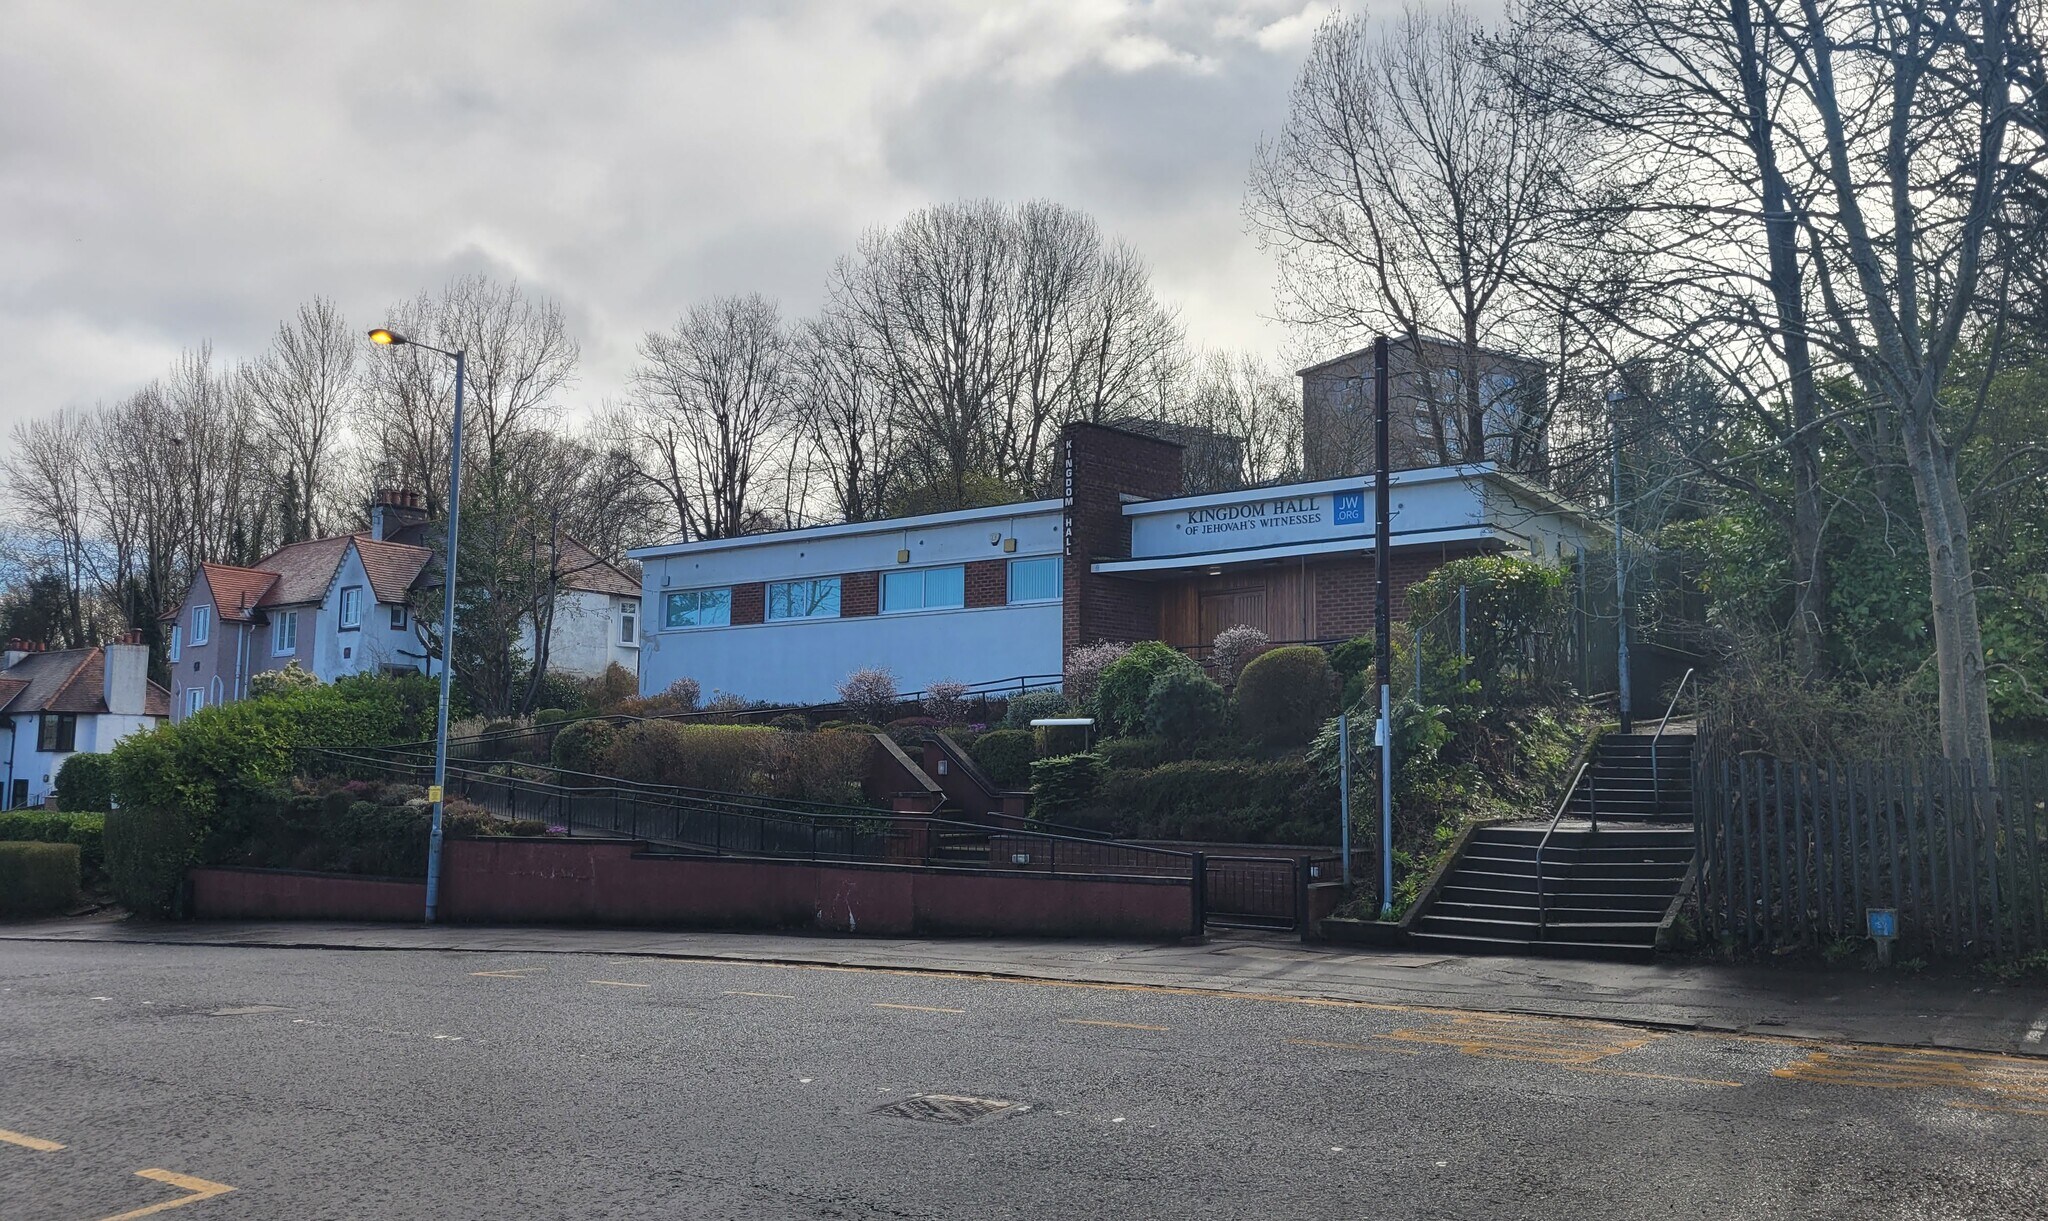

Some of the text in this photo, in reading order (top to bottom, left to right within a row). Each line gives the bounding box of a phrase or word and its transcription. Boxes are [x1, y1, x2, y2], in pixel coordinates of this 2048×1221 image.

[1064, 440, 1073, 506] KINGDOM
[1187, 497, 1320, 524] KINGDOM HALL
[1338, 495, 1359, 510] JW
[1185, 512, 1321, 536] OF JEHOVAH'S WITNESSES
